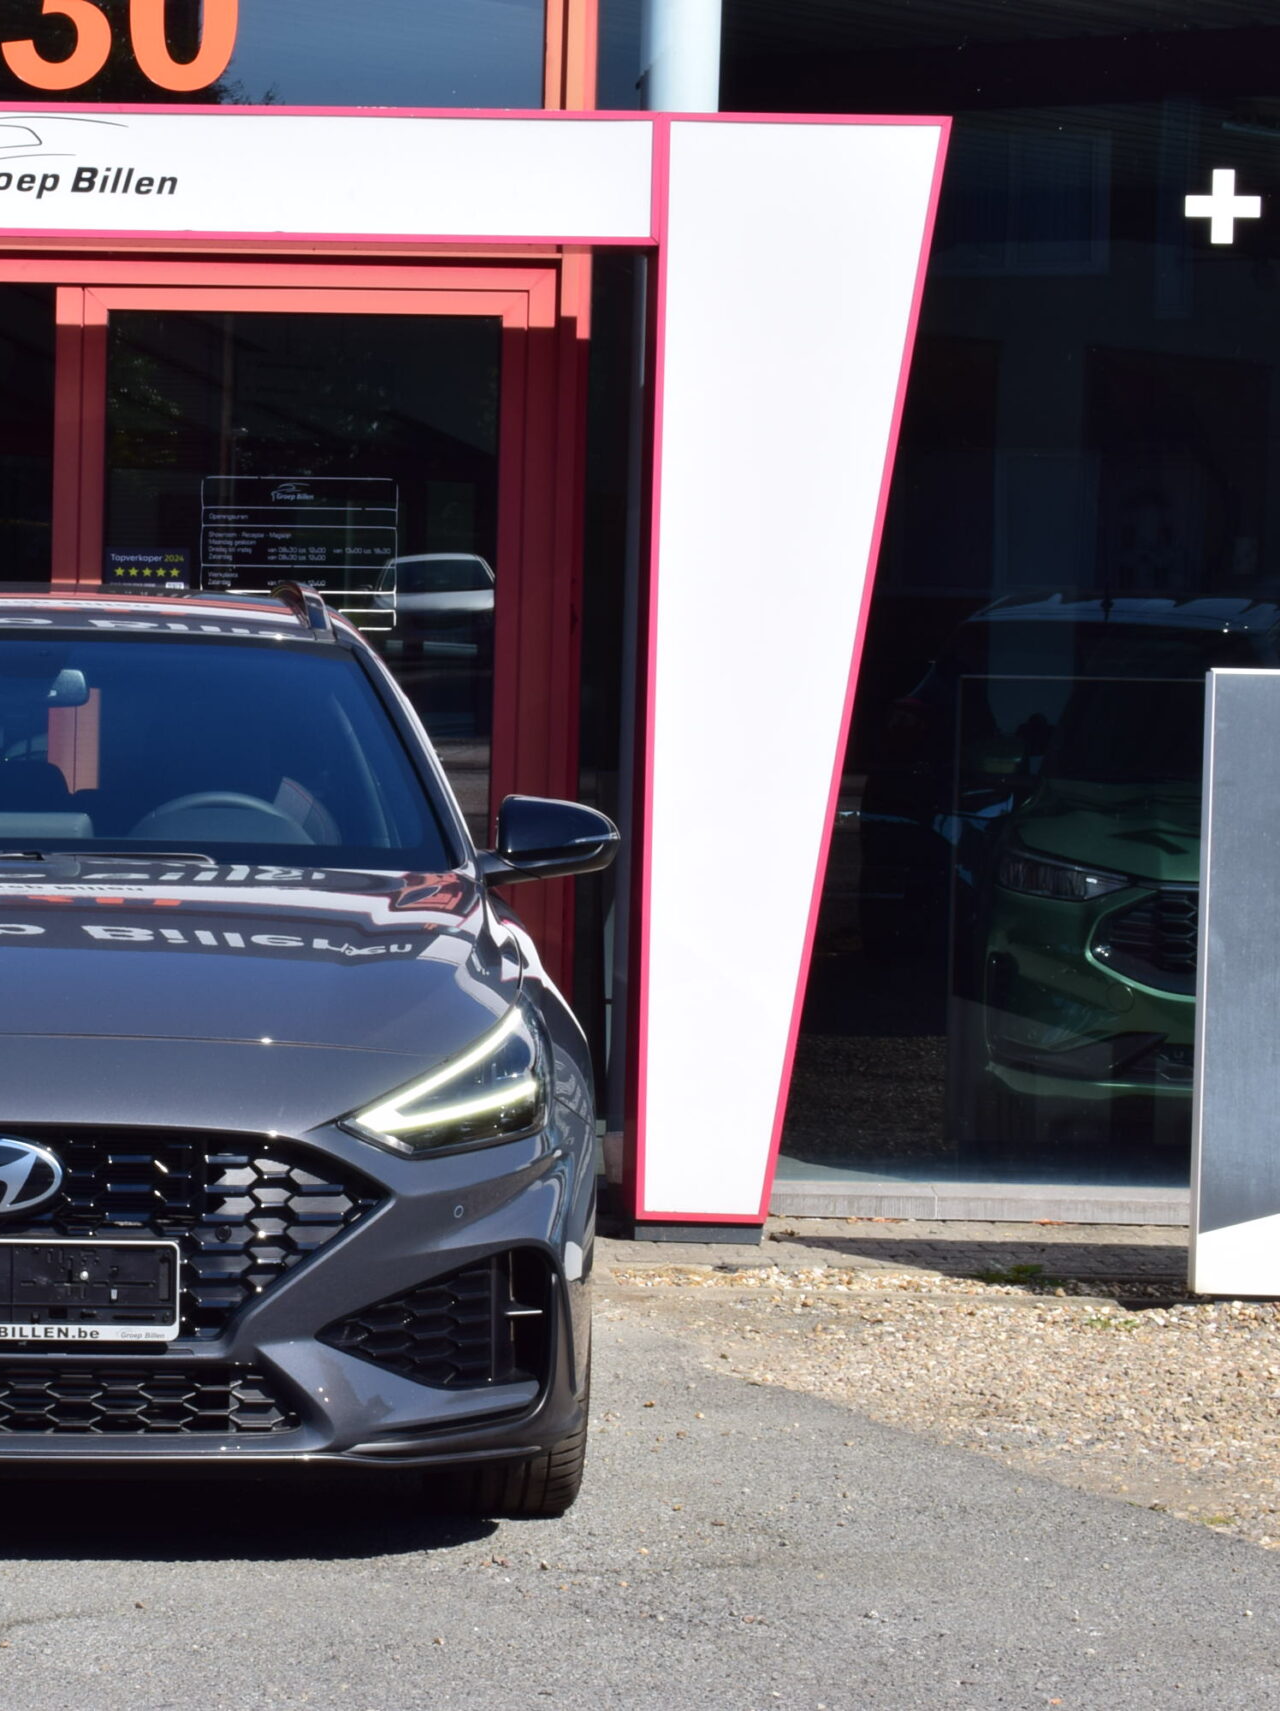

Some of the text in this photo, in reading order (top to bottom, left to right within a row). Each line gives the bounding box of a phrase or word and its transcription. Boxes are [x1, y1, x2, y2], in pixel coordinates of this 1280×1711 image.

[71, 166, 178, 195] Billen
[111, 553, 184, 563] Topverkoper 2024
[120, 1332, 143, 1340] Groep
